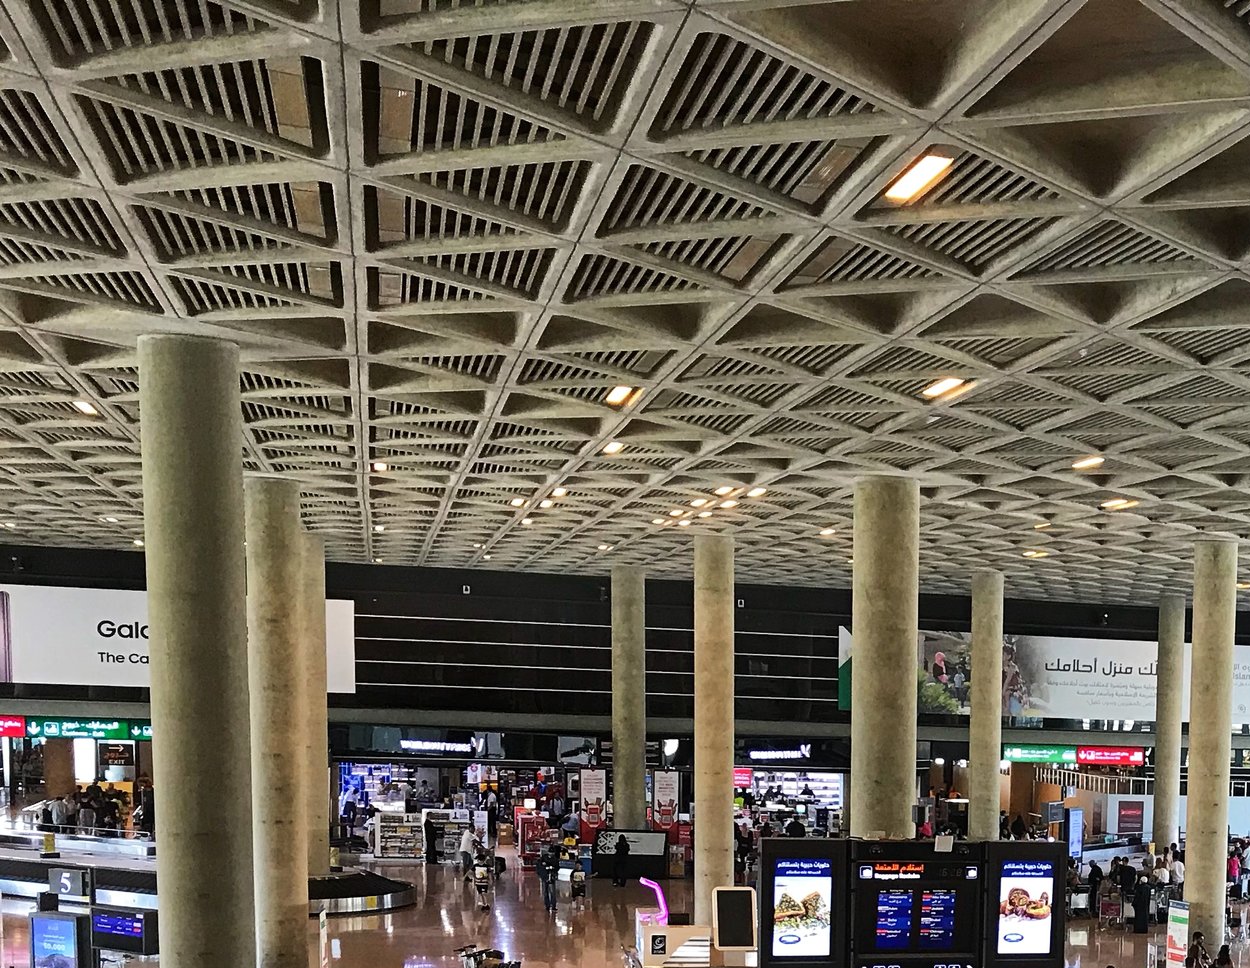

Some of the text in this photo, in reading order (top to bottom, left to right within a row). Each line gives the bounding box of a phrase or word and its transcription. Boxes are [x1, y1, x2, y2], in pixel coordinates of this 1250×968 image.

[98, 652, 125, 663] The
[1045, 657, 1098, 673] أحلامك
[1102, 661, 1133, 677] منزل
[60, 872, 72, 894] 5
